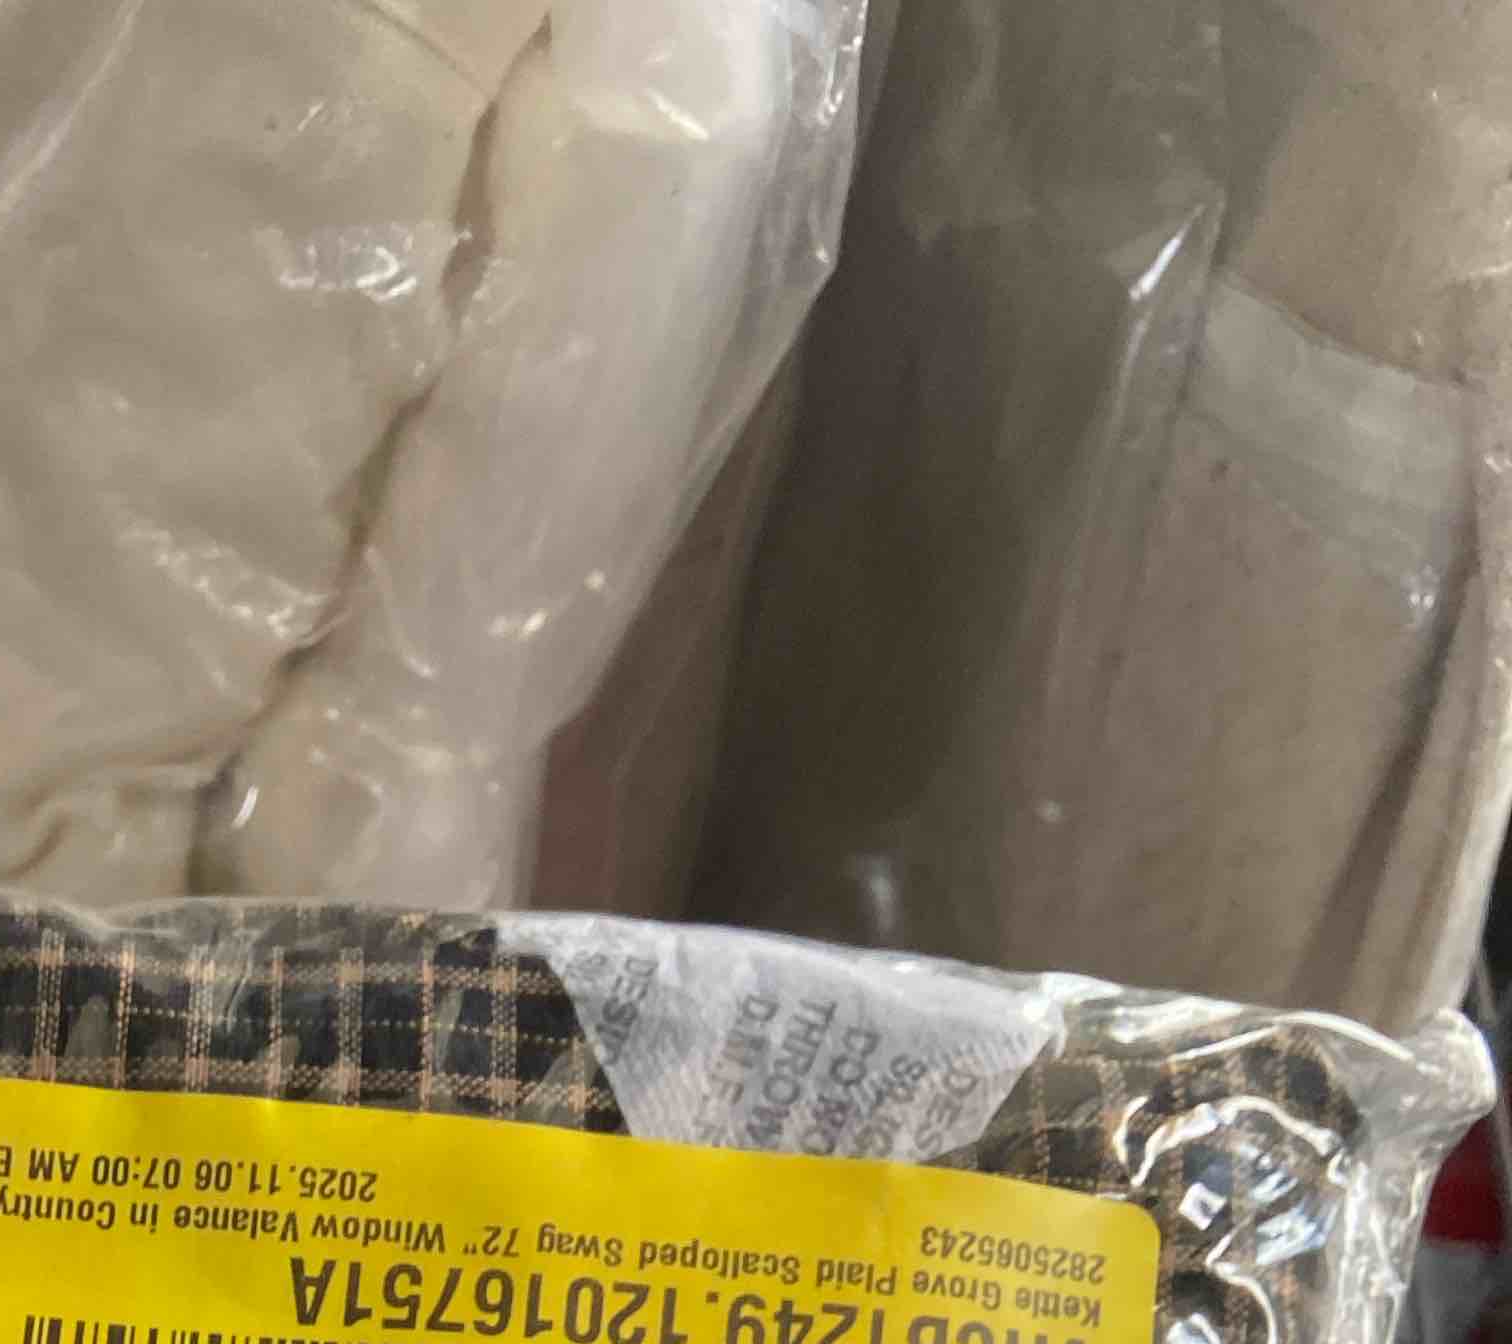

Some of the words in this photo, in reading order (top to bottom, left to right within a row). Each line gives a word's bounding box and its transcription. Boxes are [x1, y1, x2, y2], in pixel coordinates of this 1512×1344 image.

[27, 1147, 79, 1182] AM
[90, 1154, 180, 1189] 07:00
[193, 1158, 377, 1202] 2025.11.06
[128, 1201, 158, 1233] in
[172, 1204, 298, 1242] Valance
[310, 1213, 445, 1253] Window
[461, 1224, 518, 1257] 72"
[535, 1221, 623, 1266] Swag
[919, 1224, 1106, 1285] 2825065243
[637, 1238, 800, 1285] Scalloped
[814, 1257, 897, 1295] Plaid
[911, 1269, 1001, 1310] Grove
[1014, 1286, 1100, 1327] Kettle
